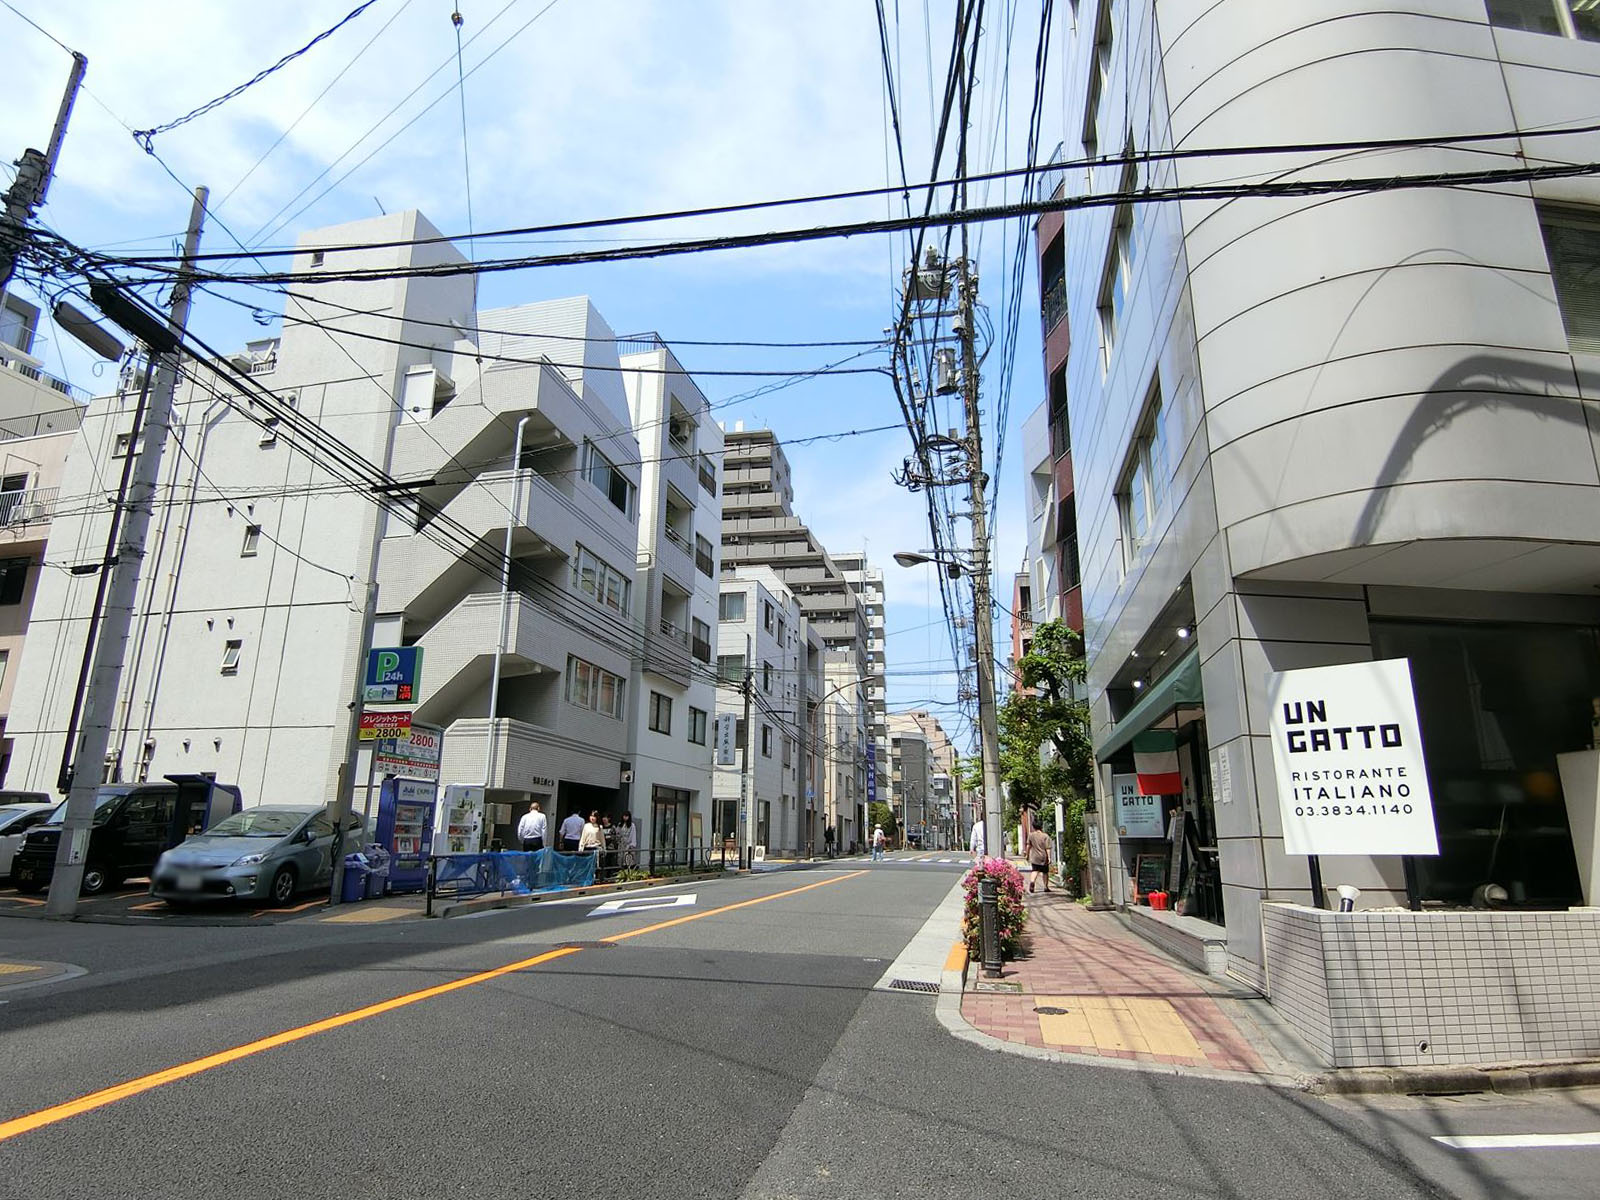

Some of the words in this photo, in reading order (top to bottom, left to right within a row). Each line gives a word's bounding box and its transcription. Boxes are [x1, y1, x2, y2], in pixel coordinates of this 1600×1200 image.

[376, 651, 400, 682] P
[384, 671, 404, 681] 24h
[363, 714, 410, 723] クレジットカード
[1283, 700, 1327, 725] UN
[1286, 723, 1402, 753] GATTO
[1292, 767, 1407, 781] RISTORANTE
[1121, 785, 1134, 795] UN
[1294, 784, 1410, 800] ITALIANO
[1122, 795, 1154, 806] GATTO
[1295, 804, 1413, 816] 03.3834.1140
